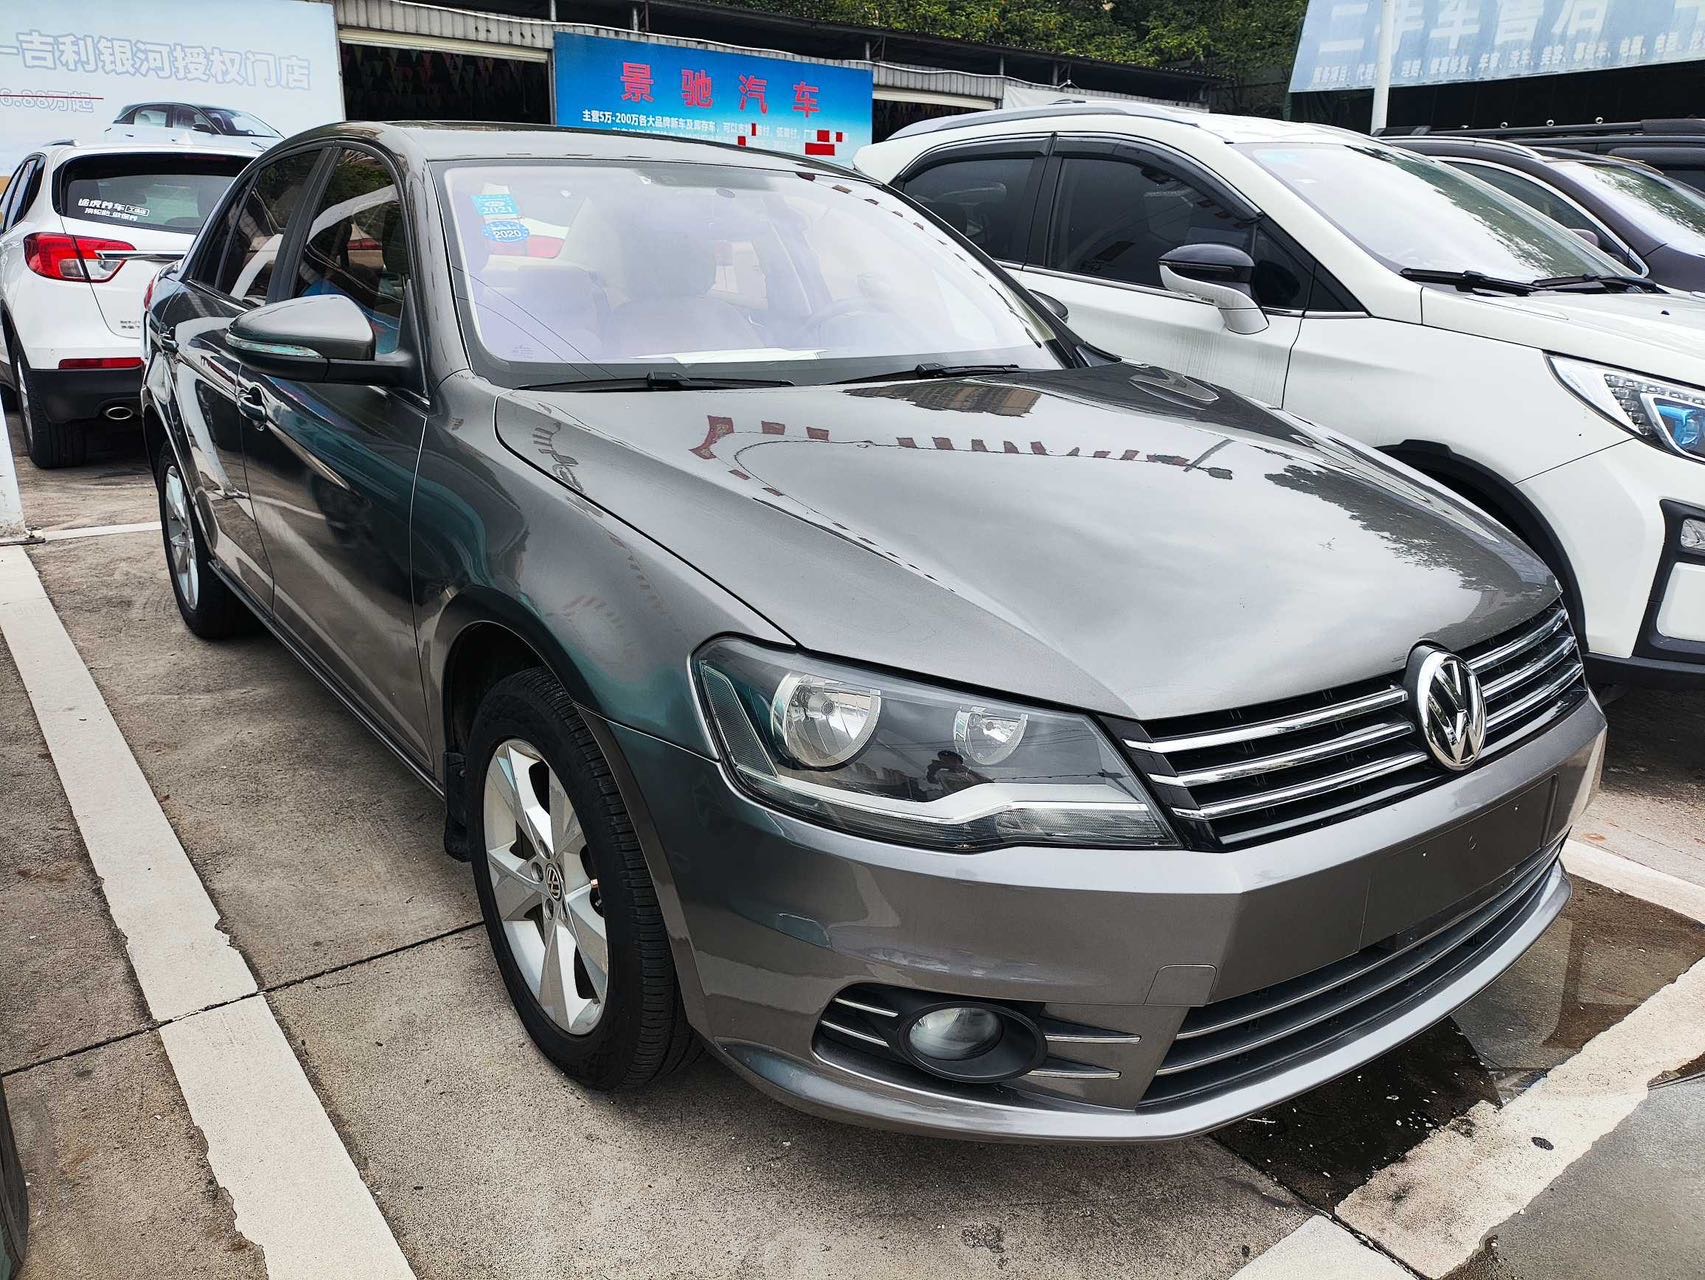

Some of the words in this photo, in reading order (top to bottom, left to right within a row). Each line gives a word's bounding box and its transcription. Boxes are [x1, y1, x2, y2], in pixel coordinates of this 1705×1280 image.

[620, 61, 821, 118] 景驰汽车
[494, 229, 522, 239] 2020
